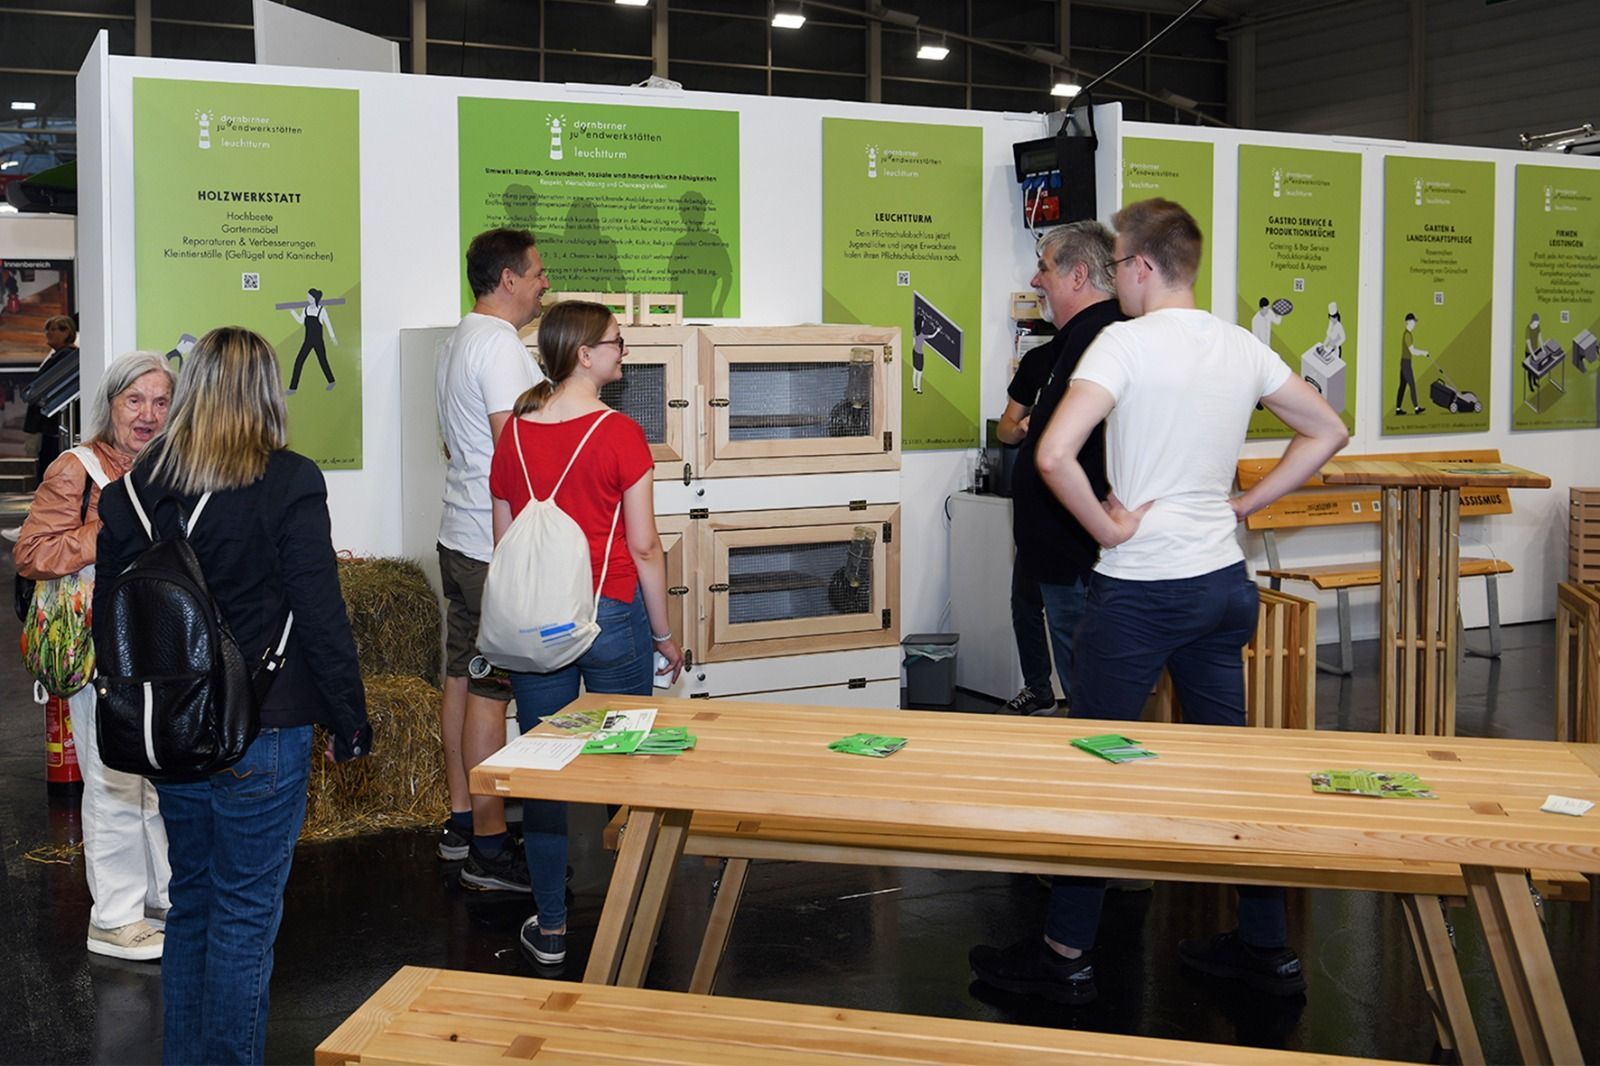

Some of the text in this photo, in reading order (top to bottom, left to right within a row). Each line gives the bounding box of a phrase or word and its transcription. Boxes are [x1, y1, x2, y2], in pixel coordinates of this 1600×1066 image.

[220, 114, 270, 124] dornbirner
[216, 119, 303, 134] jugendwerkstätten
[573, 120, 627, 130] dornbirner
[569, 124, 662, 142] jugendwerkstätten
[221, 137, 271, 149] leuchtturm
[574, 146, 627, 159] leuchtturm
[485, 167, 514, 175] Umwelt,
[515, 168, 543, 177] Bildung,
[544, 169, 586, 178] Gesundheit,
[197, 190, 302, 203] HOLZWERKSTATT
[227, 211, 274, 222] Hochbeete
[875, 213, 933, 223] LEUCHTTURM
[1268, 215, 1333, 228] GASTRO SERVICE &
[221, 224, 279, 235] Gartenmöbel
[1265, 226, 1336, 239] PRODUKTIONSKÜCHE
[1424, 223, 1456, 233] GARTEN &
[855, 229, 871, 238] Dein
[872, 229, 934, 239] Pflichtschulabschluss
[1406, 234, 1473, 245] LANDSCHAFTSPFLEGE
[1556, 229, 1579, 239] FIRMEN
[182, 236, 316, 250] Reparaturen & Verbesserungen
[849, 240, 957, 252] Jugendliche und junge Erwachsene
[1268, 242, 1293, 252] Catering
[1299, 243, 1309, 252] Bar
[1310, 243, 1330, 252] Service
[1548, 239, 1585, 249] LEISTUNGEN
[164, 249, 334, 263] Kleintierställe (Geflügel und Kaninchen)
[844, 250, 862, 259] holen
[864, 251, 879, 260] ihren
[881, 251, 943, 262] Pflichtschulabschluss
[1277, 252, 1322, 261] Produktionsküche
[4, 261, 52, 269] Innenbereich
[1270, 261, 1300, 272] Fingerfood
[1458, 495, 1502, 510] ASSISMUS
